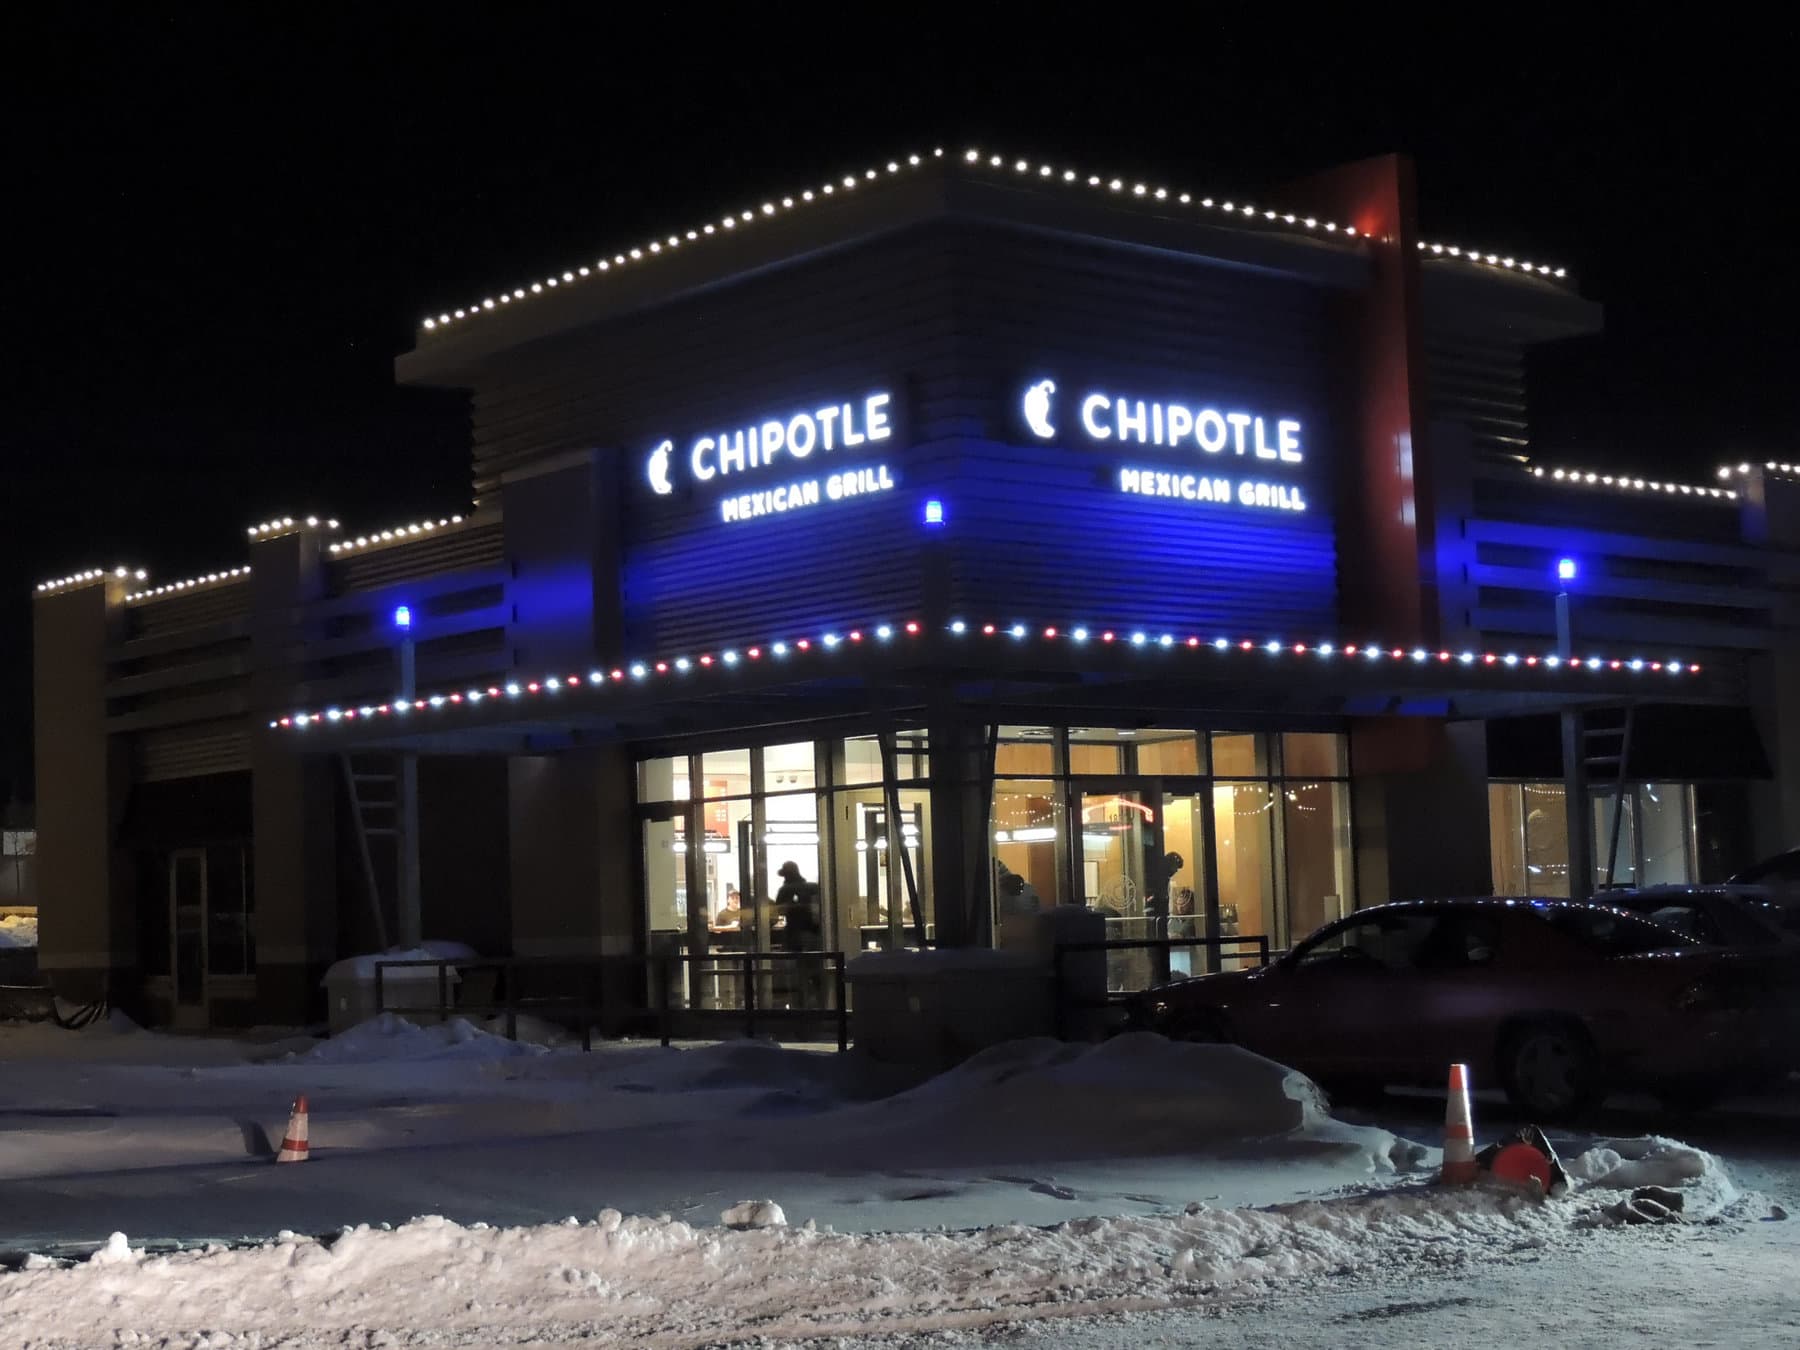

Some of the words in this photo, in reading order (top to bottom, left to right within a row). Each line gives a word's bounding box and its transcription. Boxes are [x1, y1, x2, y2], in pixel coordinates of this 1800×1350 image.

[691, 392, 892, 481] CHIPOTLE
[1081, 393, 1303, 463] CHIPOTLE
[721, 479, 820, 523] MEXICAN
[825, 464, 894, 501] GRILL
[1119, 467, 1232, 503] MEXICAN
[1237, 480, 1307, 511] GRILL
